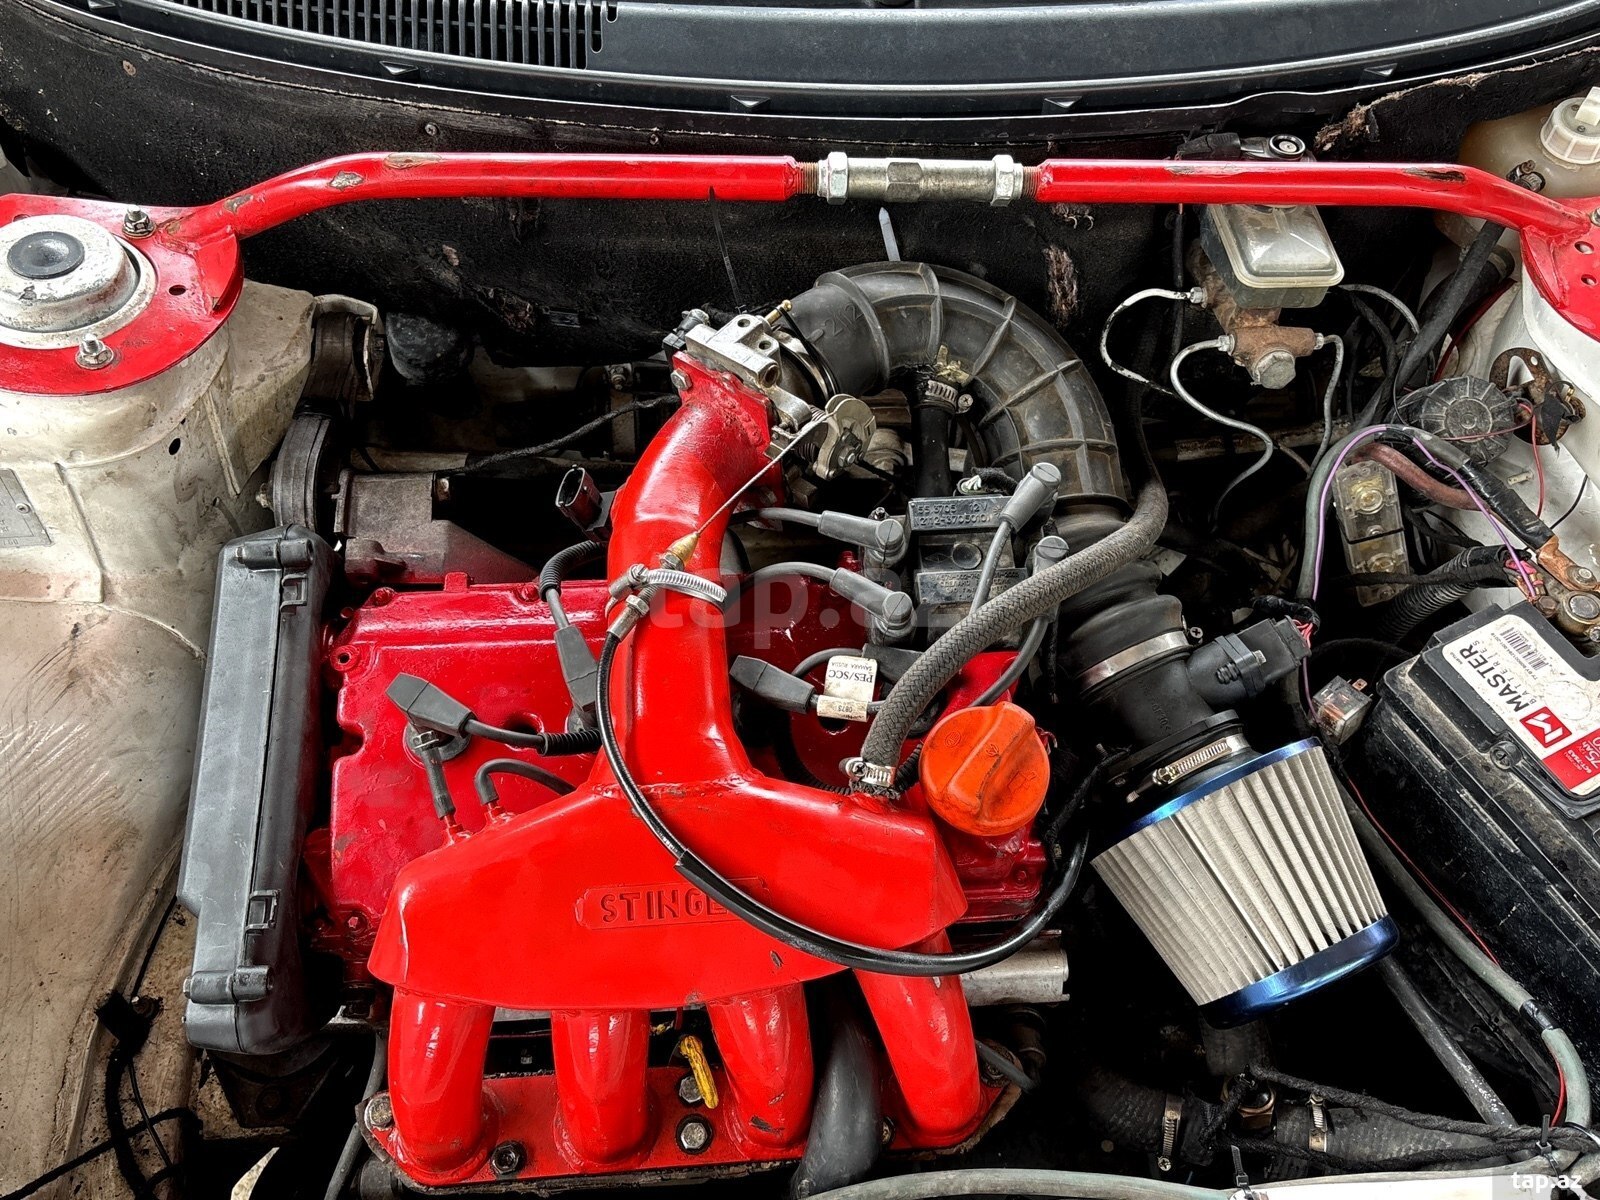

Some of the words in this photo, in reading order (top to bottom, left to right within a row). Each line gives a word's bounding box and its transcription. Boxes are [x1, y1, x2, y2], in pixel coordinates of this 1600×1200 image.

[828, 669, 874, 684] PES/SCC
[1459, 644, 1530, 713] MASTER
[1472, 640, 1537, 705] BATTERIES
[599, 888, 729, 923] STINGE
